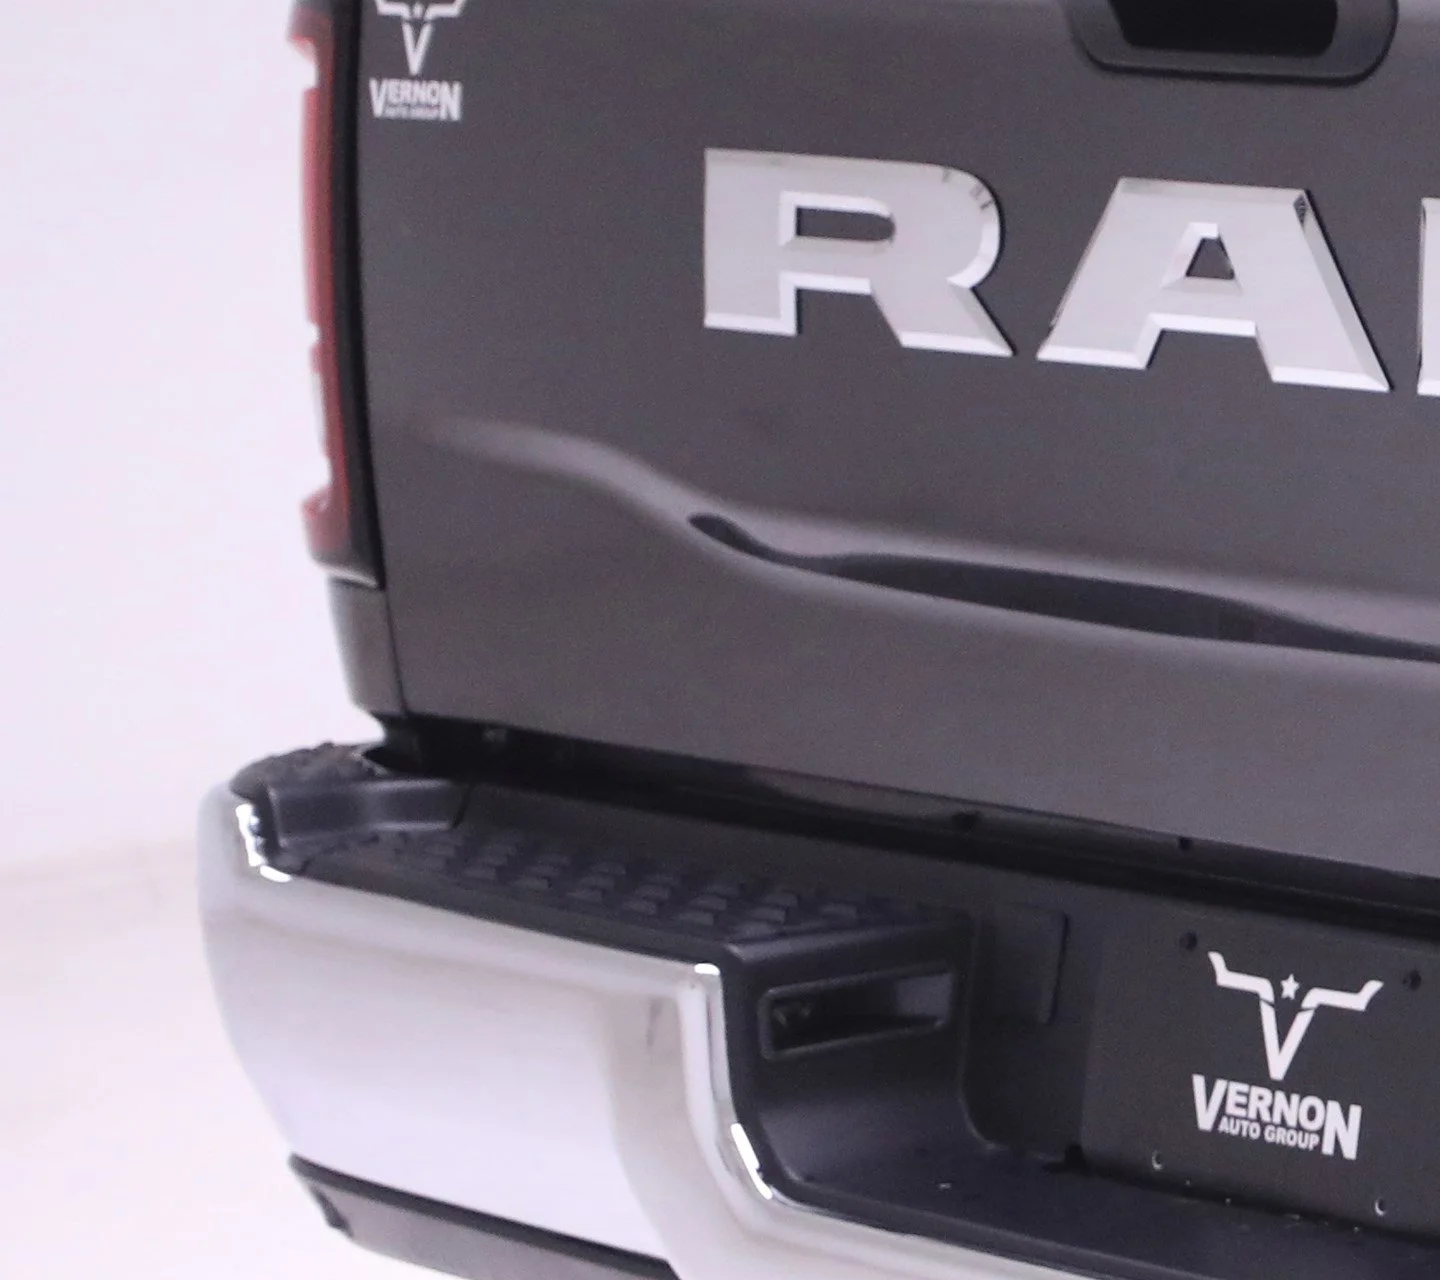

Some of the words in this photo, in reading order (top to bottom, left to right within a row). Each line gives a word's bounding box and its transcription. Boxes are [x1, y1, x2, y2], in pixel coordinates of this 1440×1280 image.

[369, 77, 463, 121] VERNON
[1192, 1074, 1362, 1160] VERNON
[1218, 1116, 1261, 1140] AUTO
[1264, 1125, 1320, 1151] GROUP
